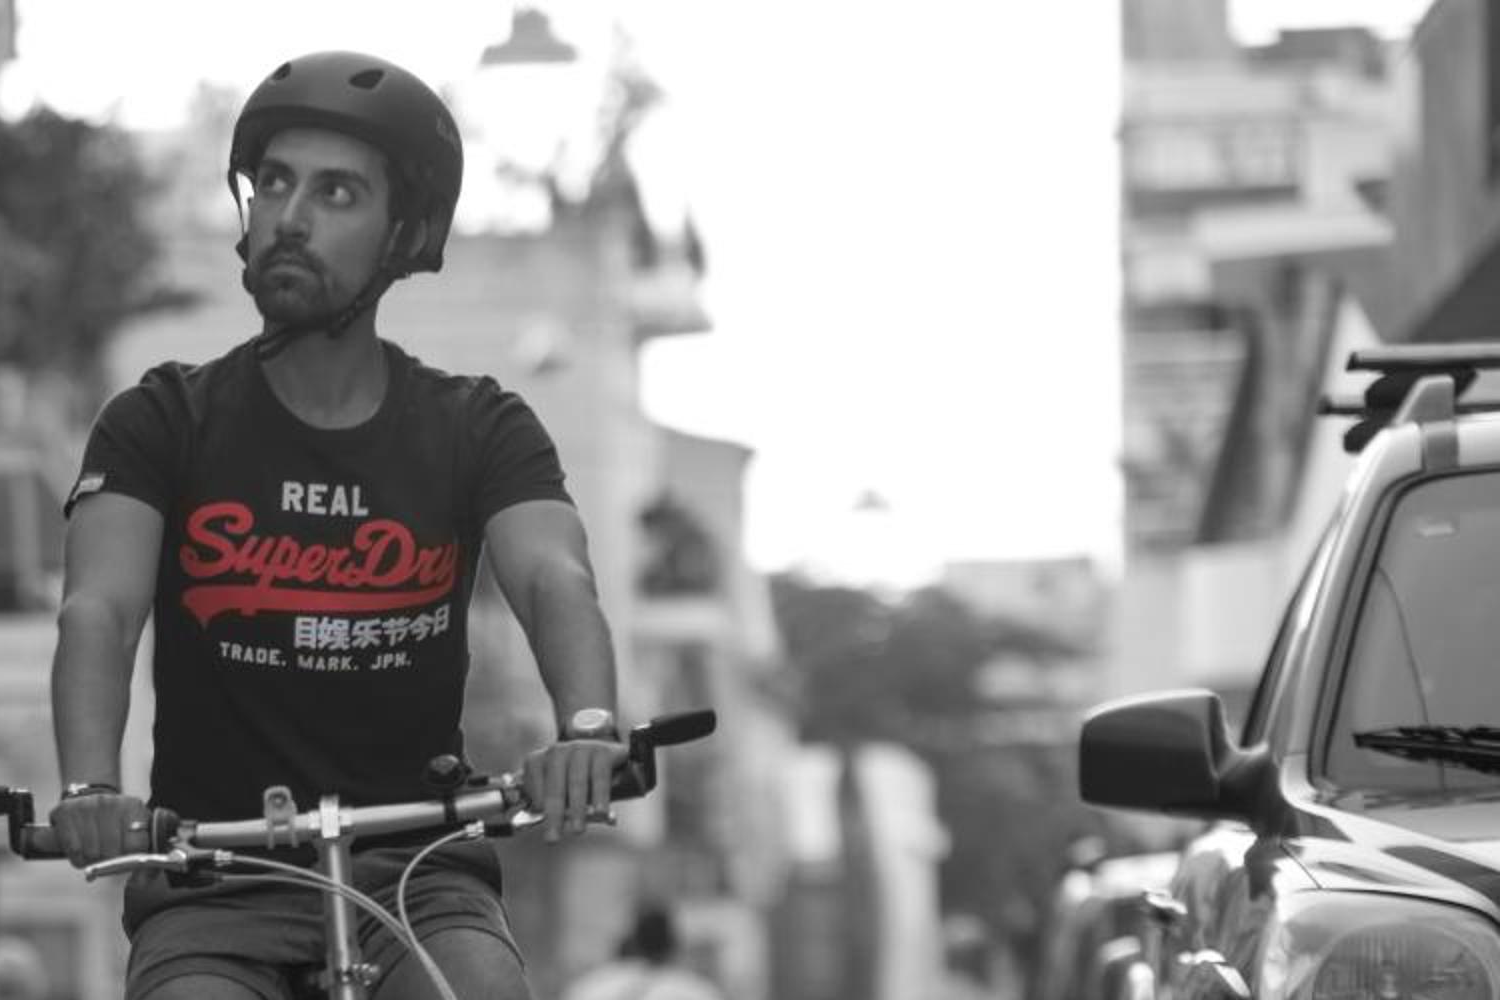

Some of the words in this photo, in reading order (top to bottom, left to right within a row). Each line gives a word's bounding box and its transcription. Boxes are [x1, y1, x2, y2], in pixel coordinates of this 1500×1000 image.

[281, 480, 369, 517] REAL
[219, 641, 287, 667] TRADE.
[297, 654, 359, 672] MARK.
